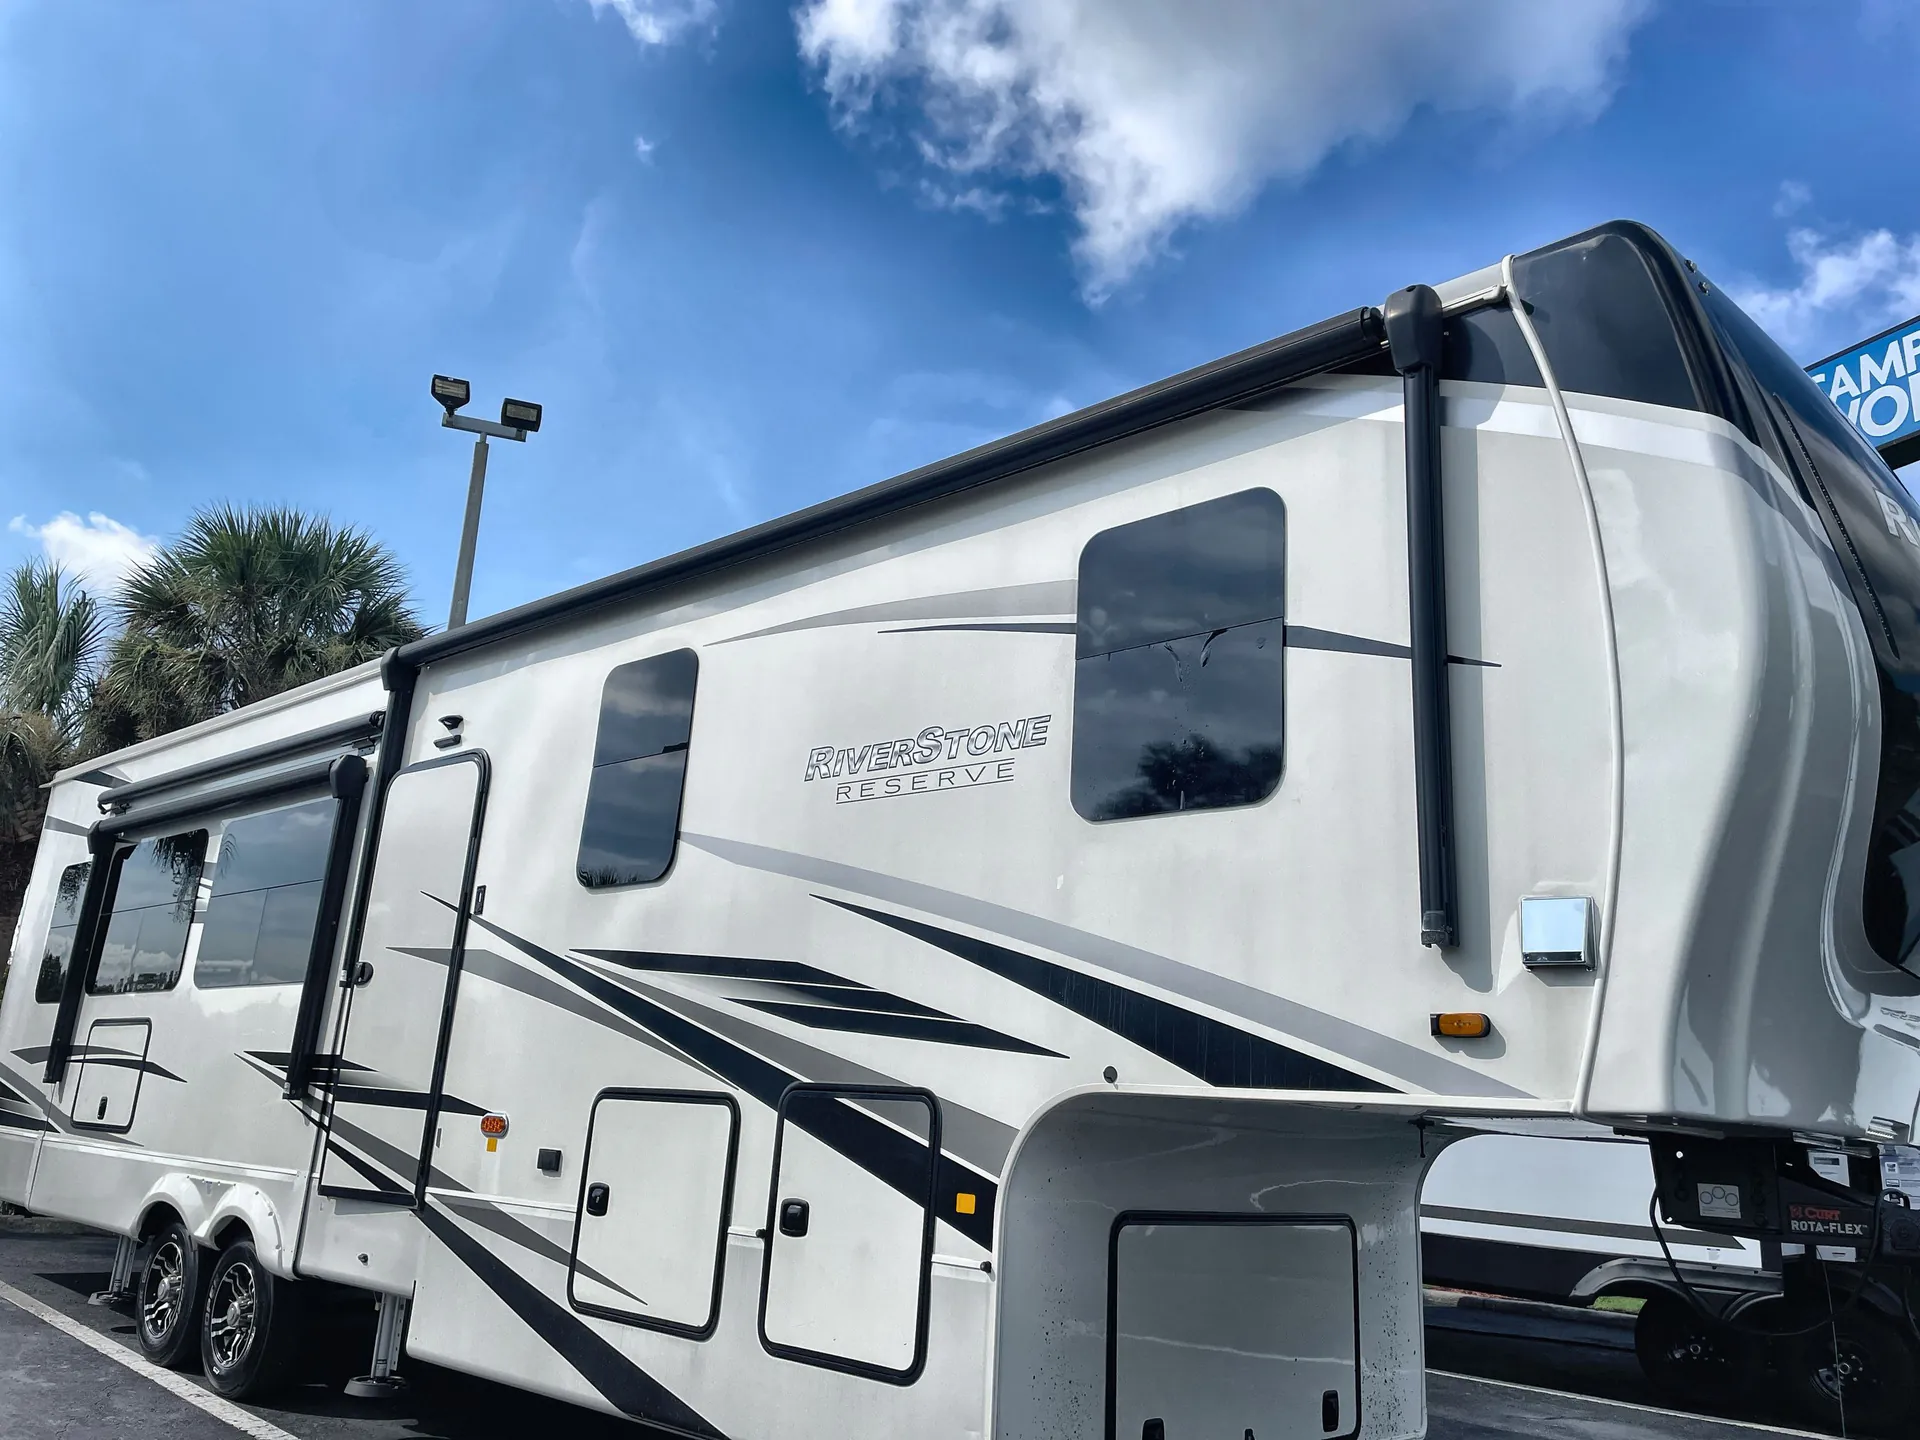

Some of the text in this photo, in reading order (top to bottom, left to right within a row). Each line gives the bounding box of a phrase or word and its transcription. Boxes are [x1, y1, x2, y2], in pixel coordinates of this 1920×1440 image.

[1811, 330, 1920, 405] AMP
[804, 714, 1051, 782] RIVERSTONE
[836, 762, 1015, 801] RESERVE
[1805, 1207, 1840, 1220] CURT
